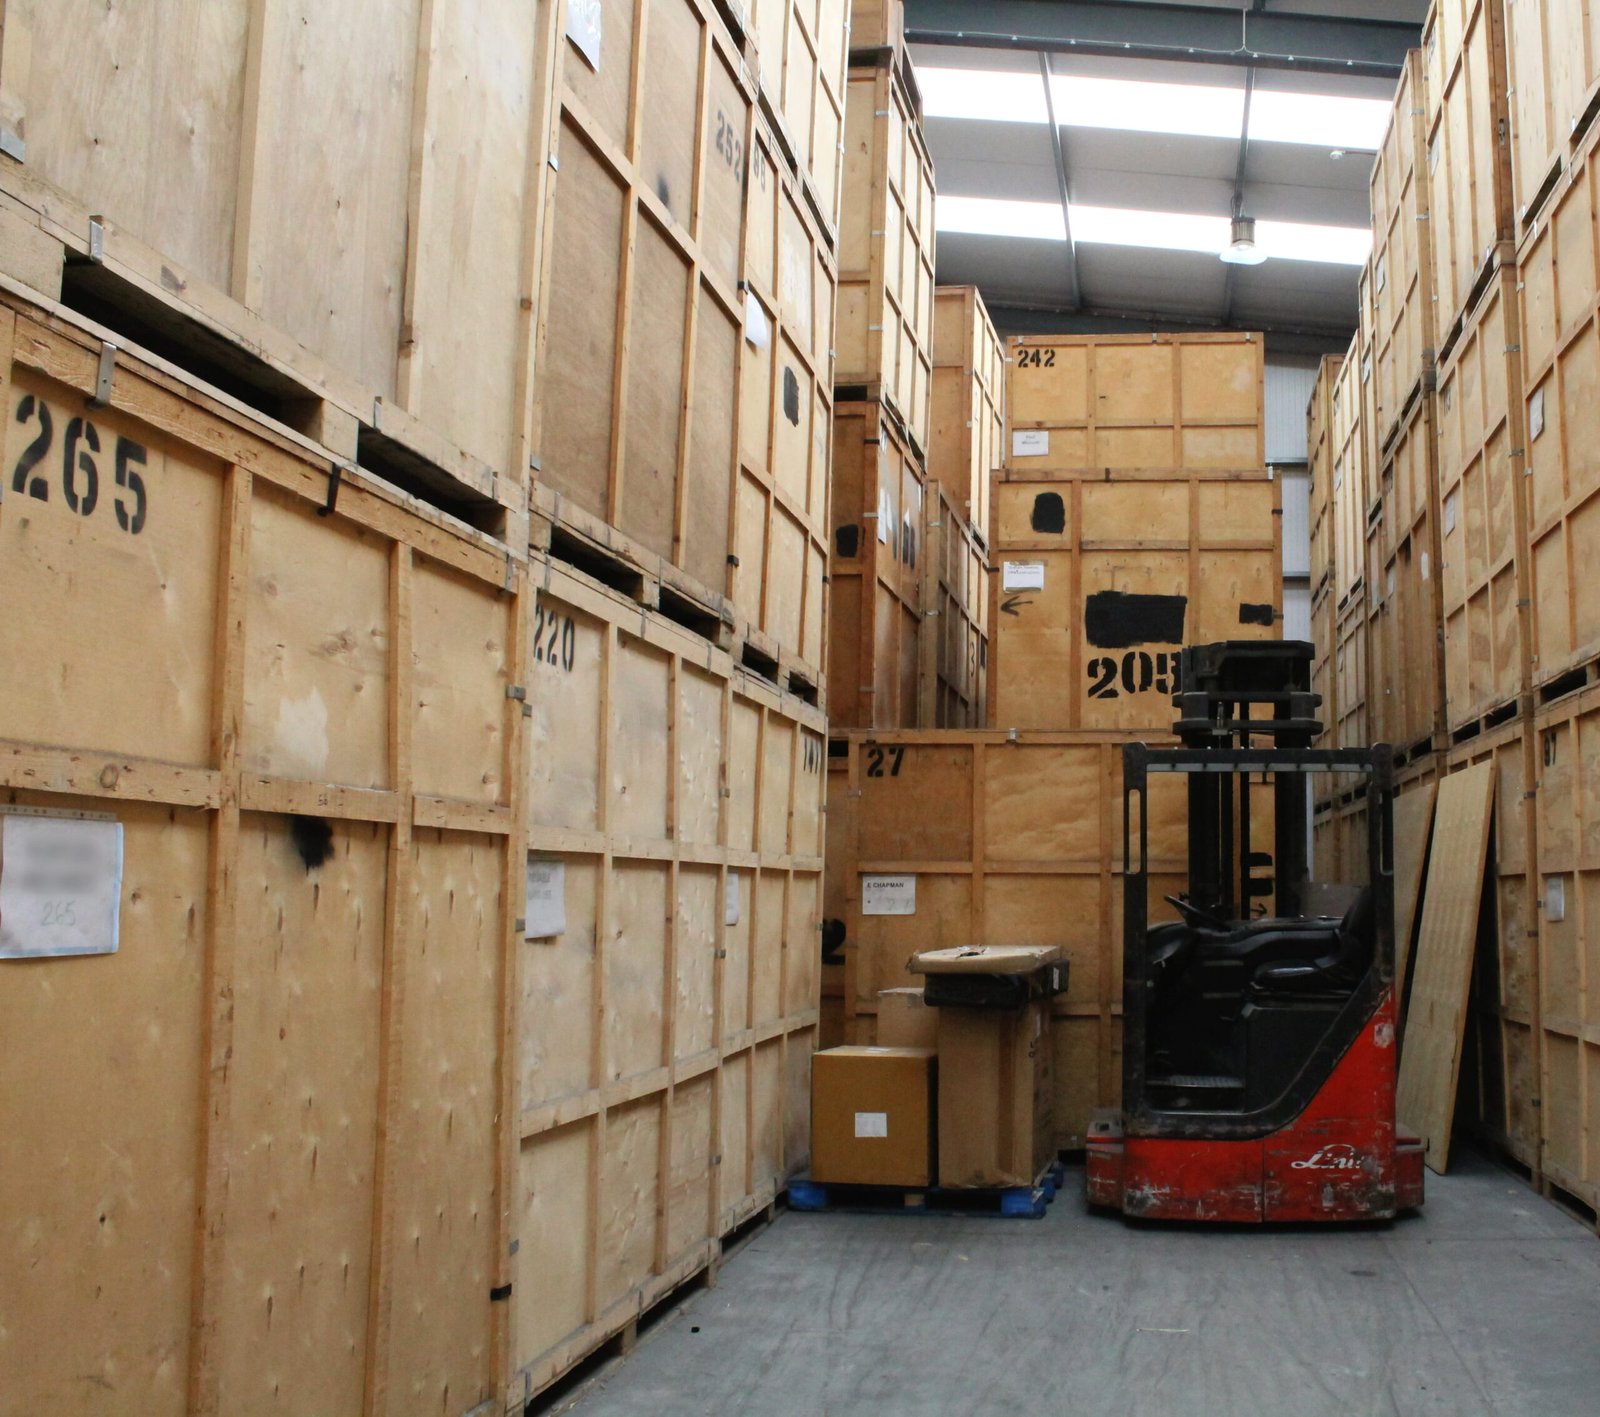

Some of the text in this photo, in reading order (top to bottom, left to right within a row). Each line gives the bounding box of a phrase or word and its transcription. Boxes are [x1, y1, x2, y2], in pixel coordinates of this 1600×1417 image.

[716, 110, 741, 182] 252
[1018, 349, 1055, 368] 242
[12, 394, 148, 535] 265
[534, 603, 575, 673] 220
[1087, 651, 1182, 699] 205
[867, 747, 905, 777] 27
[41, 900, 76, 926] 265
